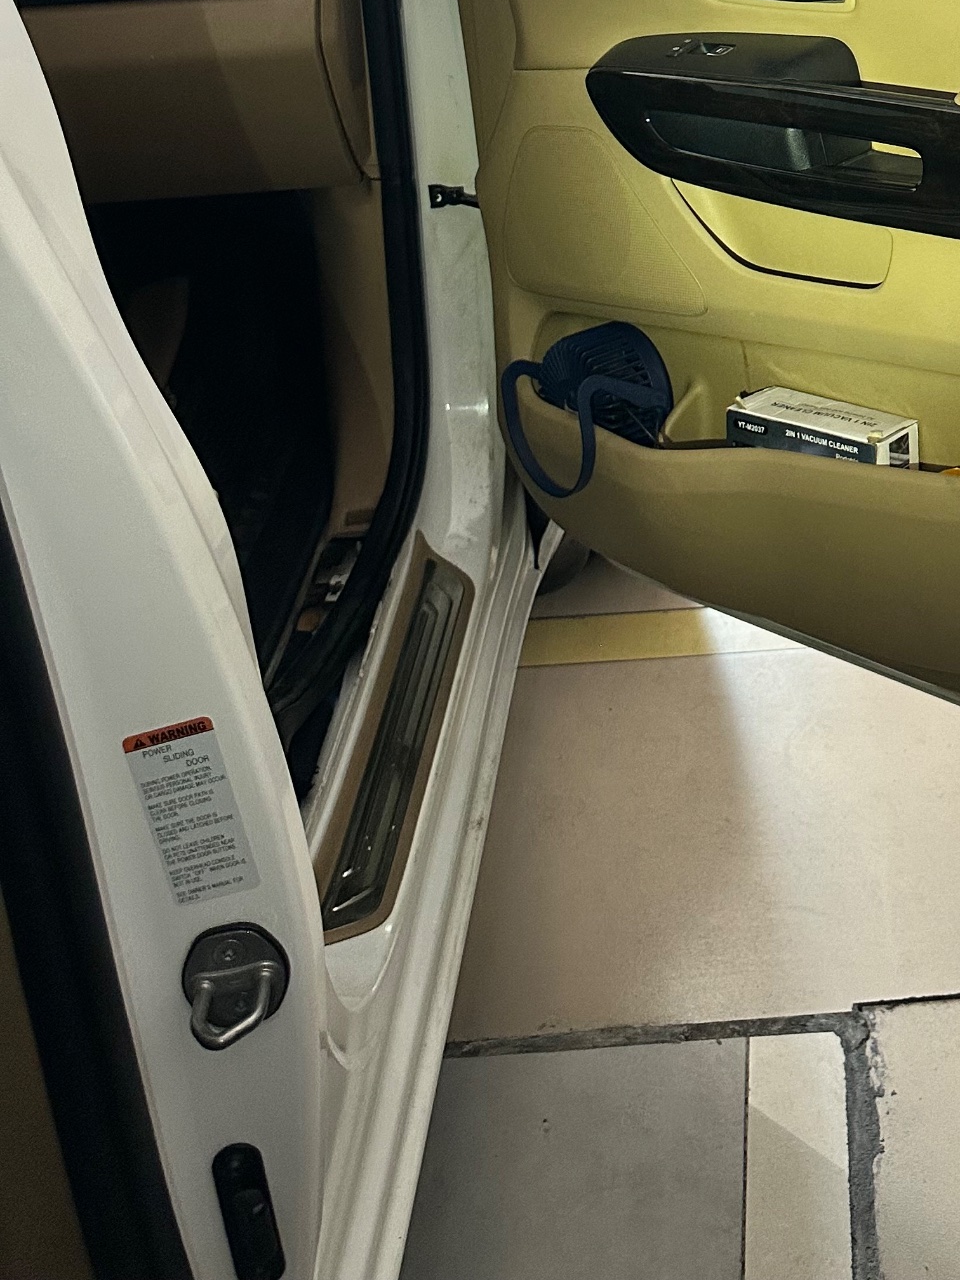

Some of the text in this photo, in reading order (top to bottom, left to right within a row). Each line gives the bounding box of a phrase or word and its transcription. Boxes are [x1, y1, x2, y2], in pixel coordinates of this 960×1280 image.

[785, 429, 796, 439] 2IN
[801, 433, 828, 447] VACUUM
[828, 440, 858, 454] CLEANER
[147, 721, 207, 744] WARNING
[142, 744, 172, 758] POWER
[163, 748, 195, 763] SLIDING
[185, 755, 210, 768] DOOR
